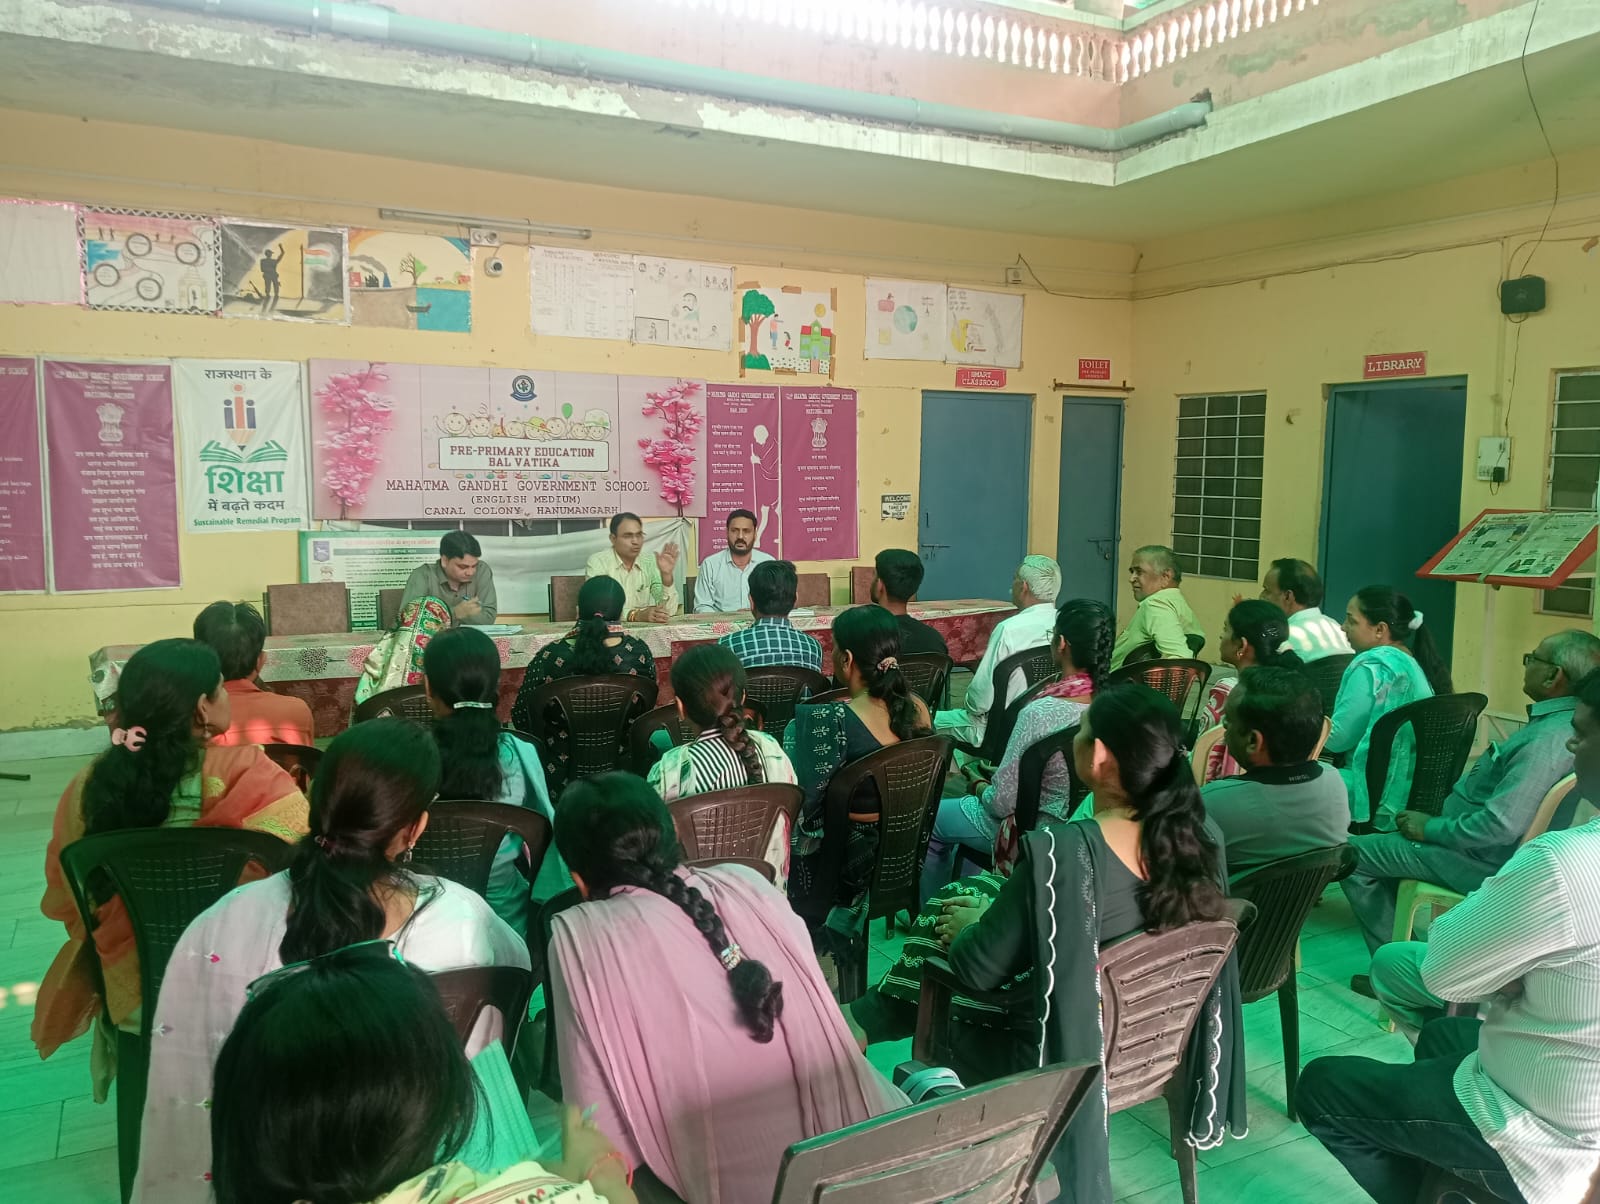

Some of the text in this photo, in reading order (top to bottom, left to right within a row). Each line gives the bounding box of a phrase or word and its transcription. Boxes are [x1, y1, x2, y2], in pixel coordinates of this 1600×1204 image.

[1080, 360, 1108, 369] TOILET
[1368, 358, 1422, 372] LIBRARY
[204, 367, 272, 380] राजस्थान के
[962, 378, 1000, 387] CLASSROOM
[450, 445, 595, 458] PRE-PRIMARY EDUCATION
[489, 457, 560, 468] BAL VATIKA
[204, 464, 285, 495] शिक्षा
[386, 480, 650, 492] MAHATMA GANDHI GOVERNMENT SCHOOL
[208, 498, 218, 511] में
[254, 500, 285, 511] कदम
[471, 495, 581, 504] (ENGLISH MEDIUM)
[424, 507, 466, 515] CANAL
[537, 506, 618, 514] HANUMANGARH
[194, 516, 301, 527] Sustainable Remedial Program
